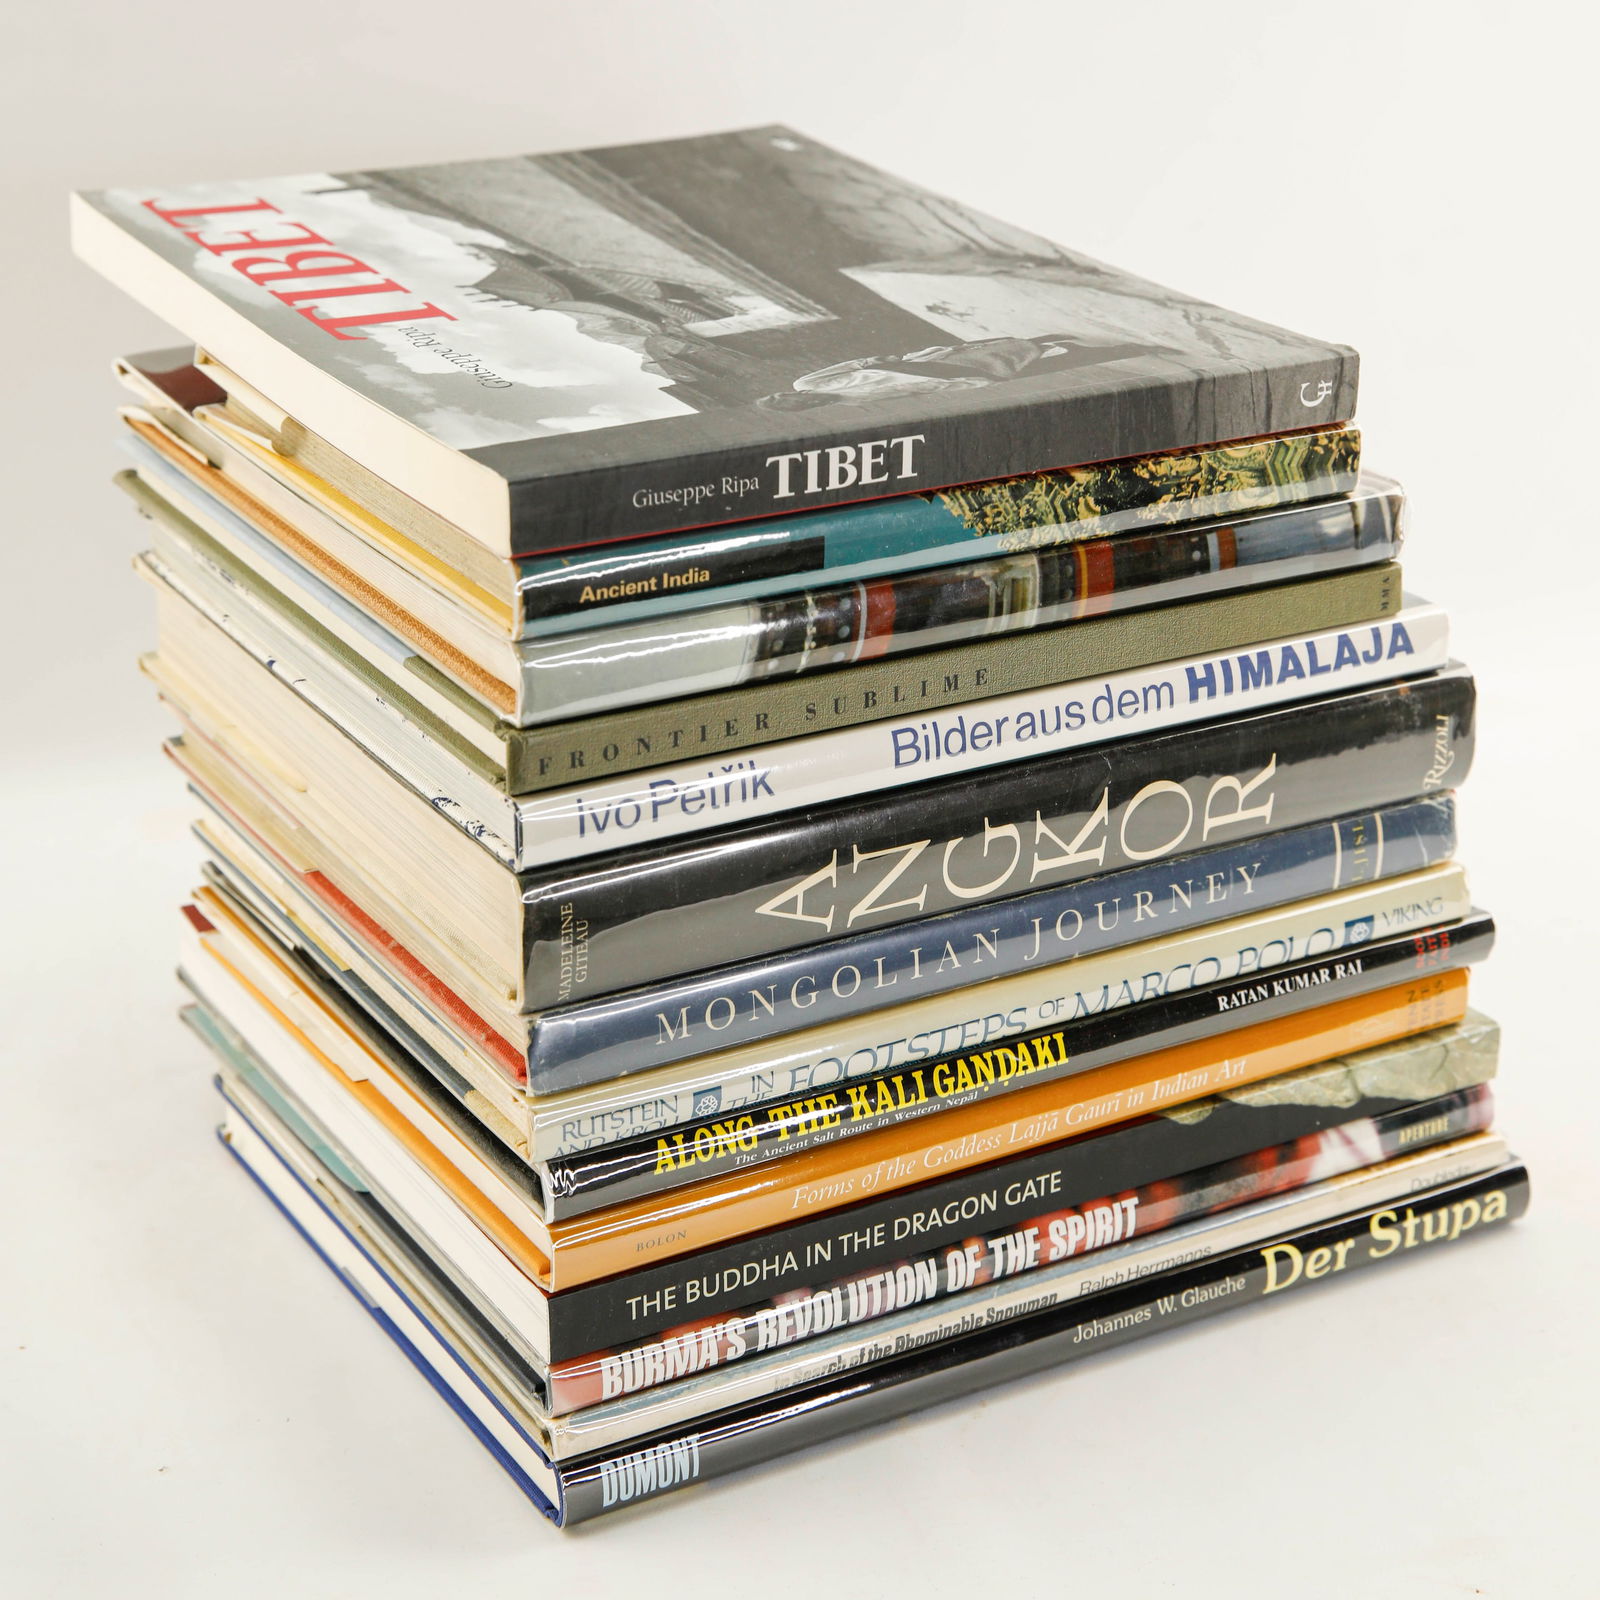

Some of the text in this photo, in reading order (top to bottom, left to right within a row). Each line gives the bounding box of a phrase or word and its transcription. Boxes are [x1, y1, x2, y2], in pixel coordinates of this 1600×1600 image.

[141, 196, 459, 341] TIBET
[398, 325, 513, 389] Giuseppe Ripa
[632, 434, 926, 509] Giuseppe Ripa TIBET
[579, 567, 711, 604] Ancient India
[539, 667, 989, 776] FRONTIER SUBLIME
[891, 621, 1415, 769] Bilder aus dem HIMALAJA
[755, 752, 1277, 932] ANGKOR
[558, 902, 573, 1001] MADELEINE
[576, 920, 589, 982] GITEAU
[655, 862, 1263, 1045] MONGOLIAN JOURNEY
[790, 897, 1444, 1092] FOOTSTEPS OF MARCO POLO VIKING
[1217, 959, 1365, 1012] RATAN KUMAR RAI
[563, 1094, 679, 1141] RUTSTEIN
[752, 1070, 775, 1094] IN
[654, 1115, 758, 1175] ALONG
[768, 1092, 840, 1142] THE
[734, 1153, 757, 1166] The
[761, 1139, 808, 1160] Ancient
[813, 1130, 834, 1145] Salt
[839, 1121, 873, 1137] Route
[878, 1116, 889, 1126] in
[895, 1103, 941, 1122] Western
[791, 1176, 854, 1209] Forms
[861, 1163, 884, 1192] of
[885, 1158, 916, 1180] the
[923, 1133, 1001, 1168] Goddess
[1127, 1087, 1144, 1107] in
[1151, 1070, 1209, 1101] Indian
[1215, 1058, 1247, 1081] Art
[625, 1171, 1063, 1321] THE BUDDHA IN THE DRAGON GATE
[635, 1229, 688, 1252] BOLON
[601, 1319, 747, 1401] BURMA'S
[757, 1256, 938, 1353] REVOLUTION
[947, 1248, 983, 1293] OF
[990, 1224, 1041, 1280] THE
[1048, 1196, 1140, 1262] SPIRIT
[867, 1340, 892, 1361] the
[894, 1313, 984, 1352] Abominable
[985, 1293, 1058, 1325] Snowman
[1080, 1273, 1124, 1296] Ralph
[601, 1189, 1508, 1507] DUMONT Johannes W. Glauche Der Stupa
